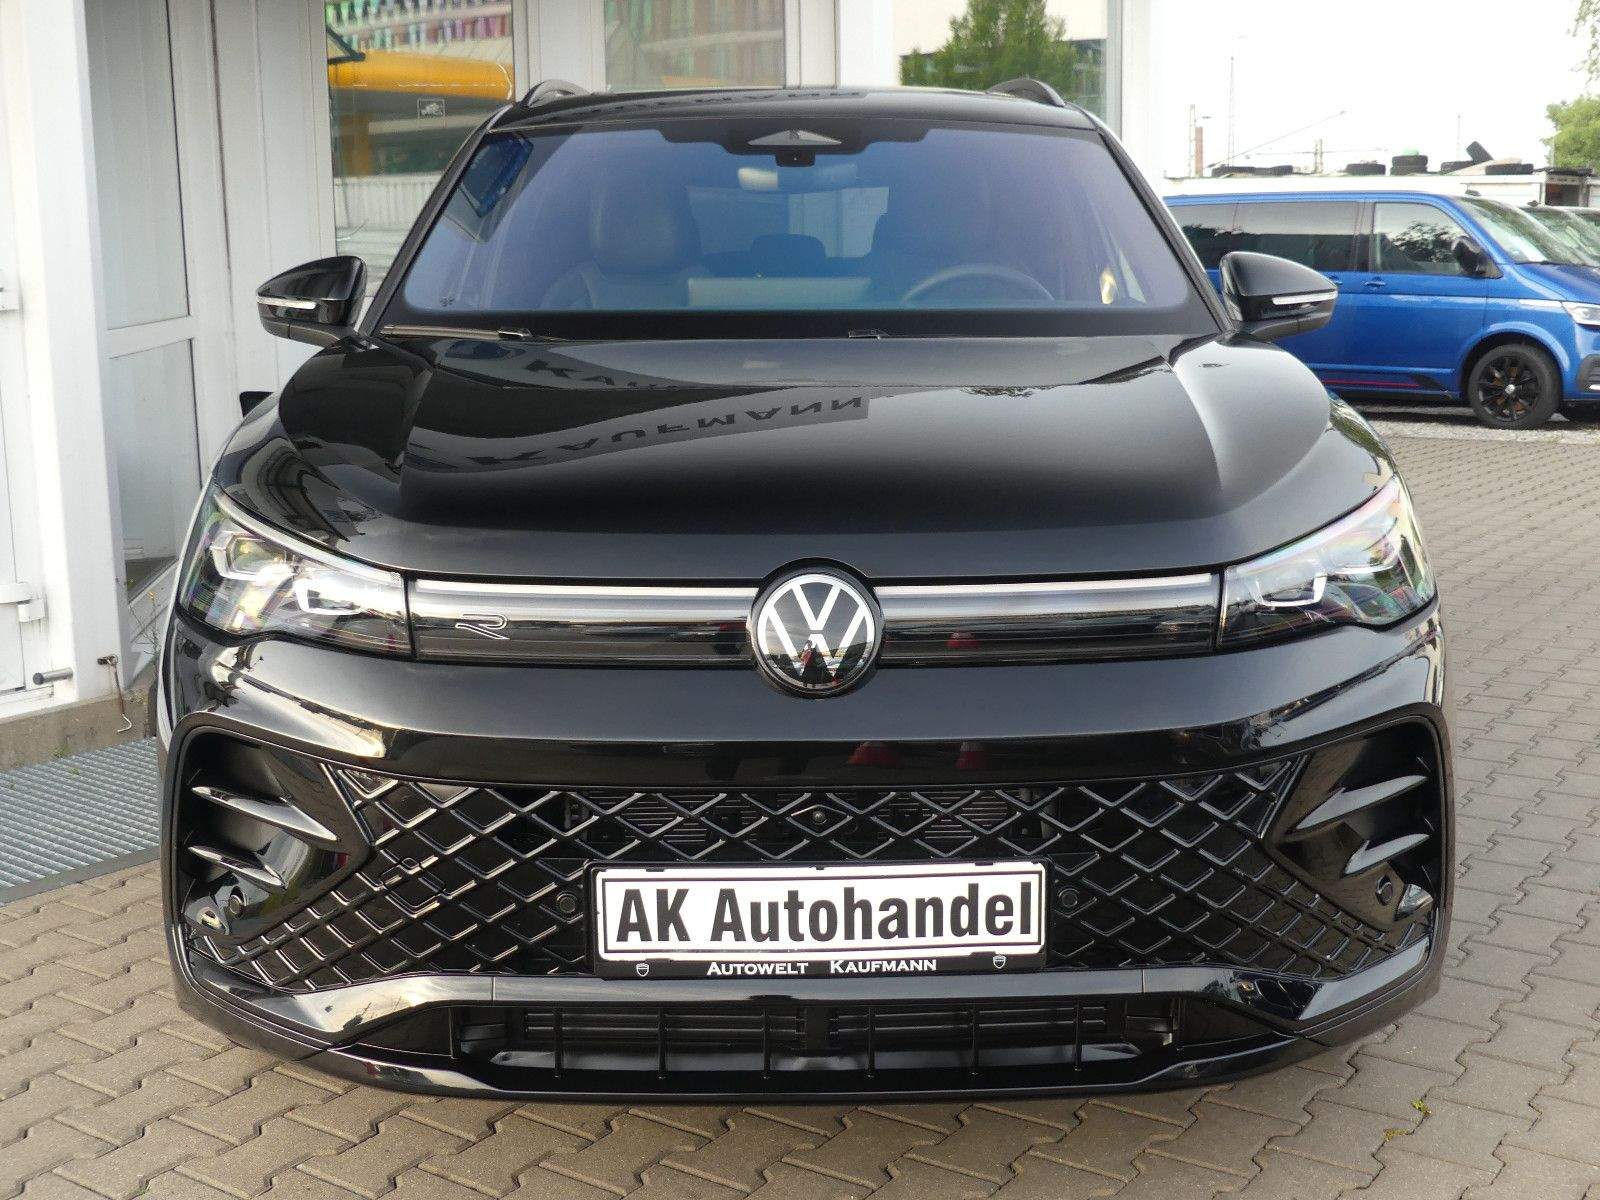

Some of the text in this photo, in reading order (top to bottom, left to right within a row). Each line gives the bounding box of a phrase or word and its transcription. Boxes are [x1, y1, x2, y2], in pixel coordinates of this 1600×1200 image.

[615, 881, 1032, 943] AK Autohandel
[706, 958, 938, 976] AUTOWELT KAUFMANN
